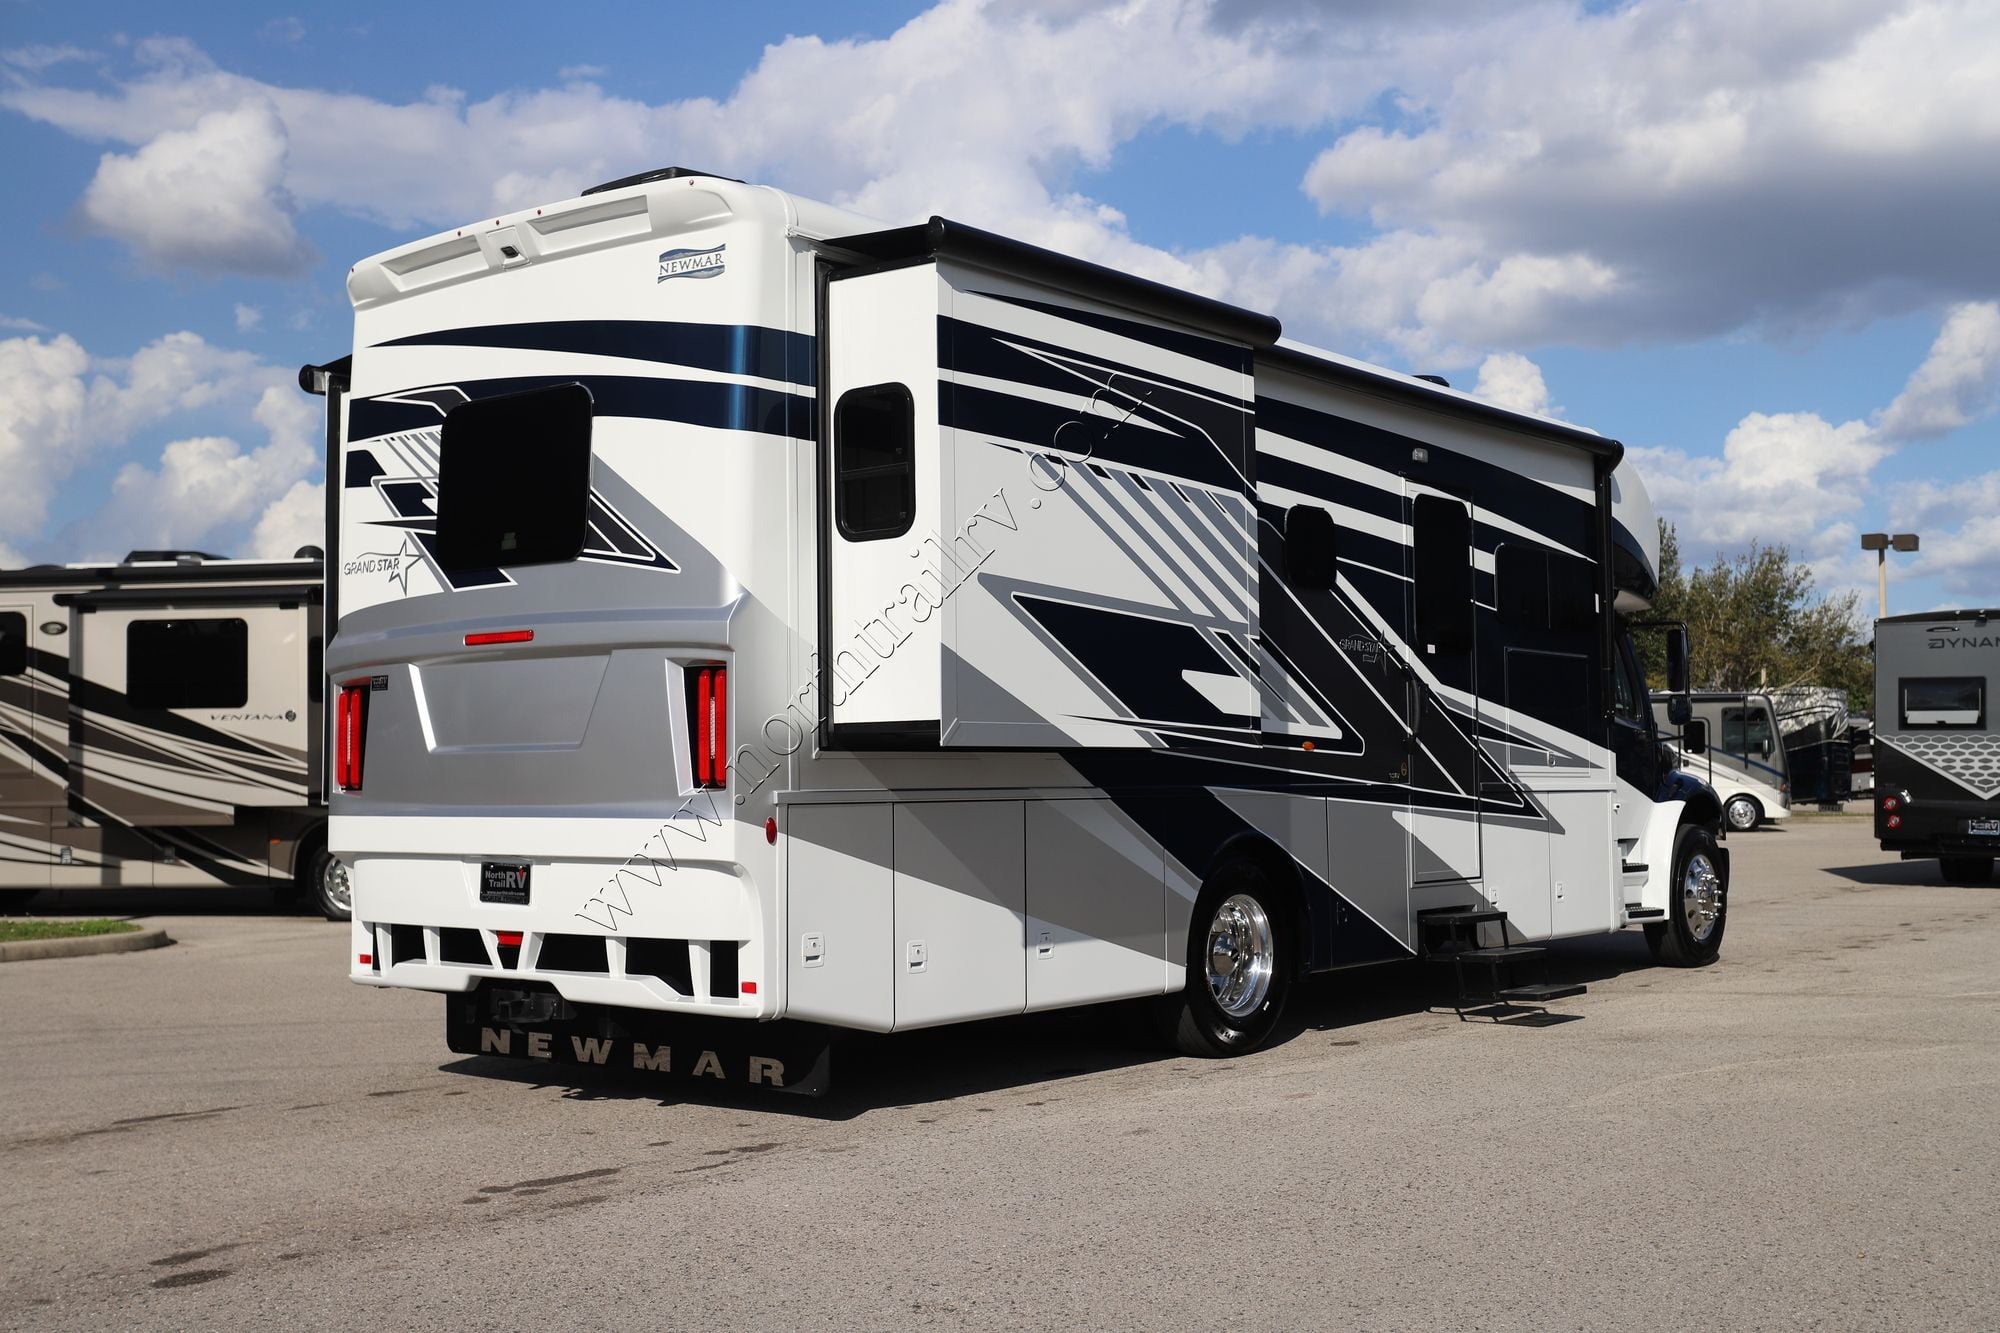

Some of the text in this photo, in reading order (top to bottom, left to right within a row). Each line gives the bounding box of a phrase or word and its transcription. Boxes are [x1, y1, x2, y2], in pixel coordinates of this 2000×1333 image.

[659, 253, 724, 275] NEWMAR
[344, 557, 400, 576] GRAND STAR
[211, 713, 284, 721] VENTANA
[485, 870, 506, 879] North
[489, 871, 527, 889] Trail RV
[478, 1026, 786, 1087] NEWMAR
